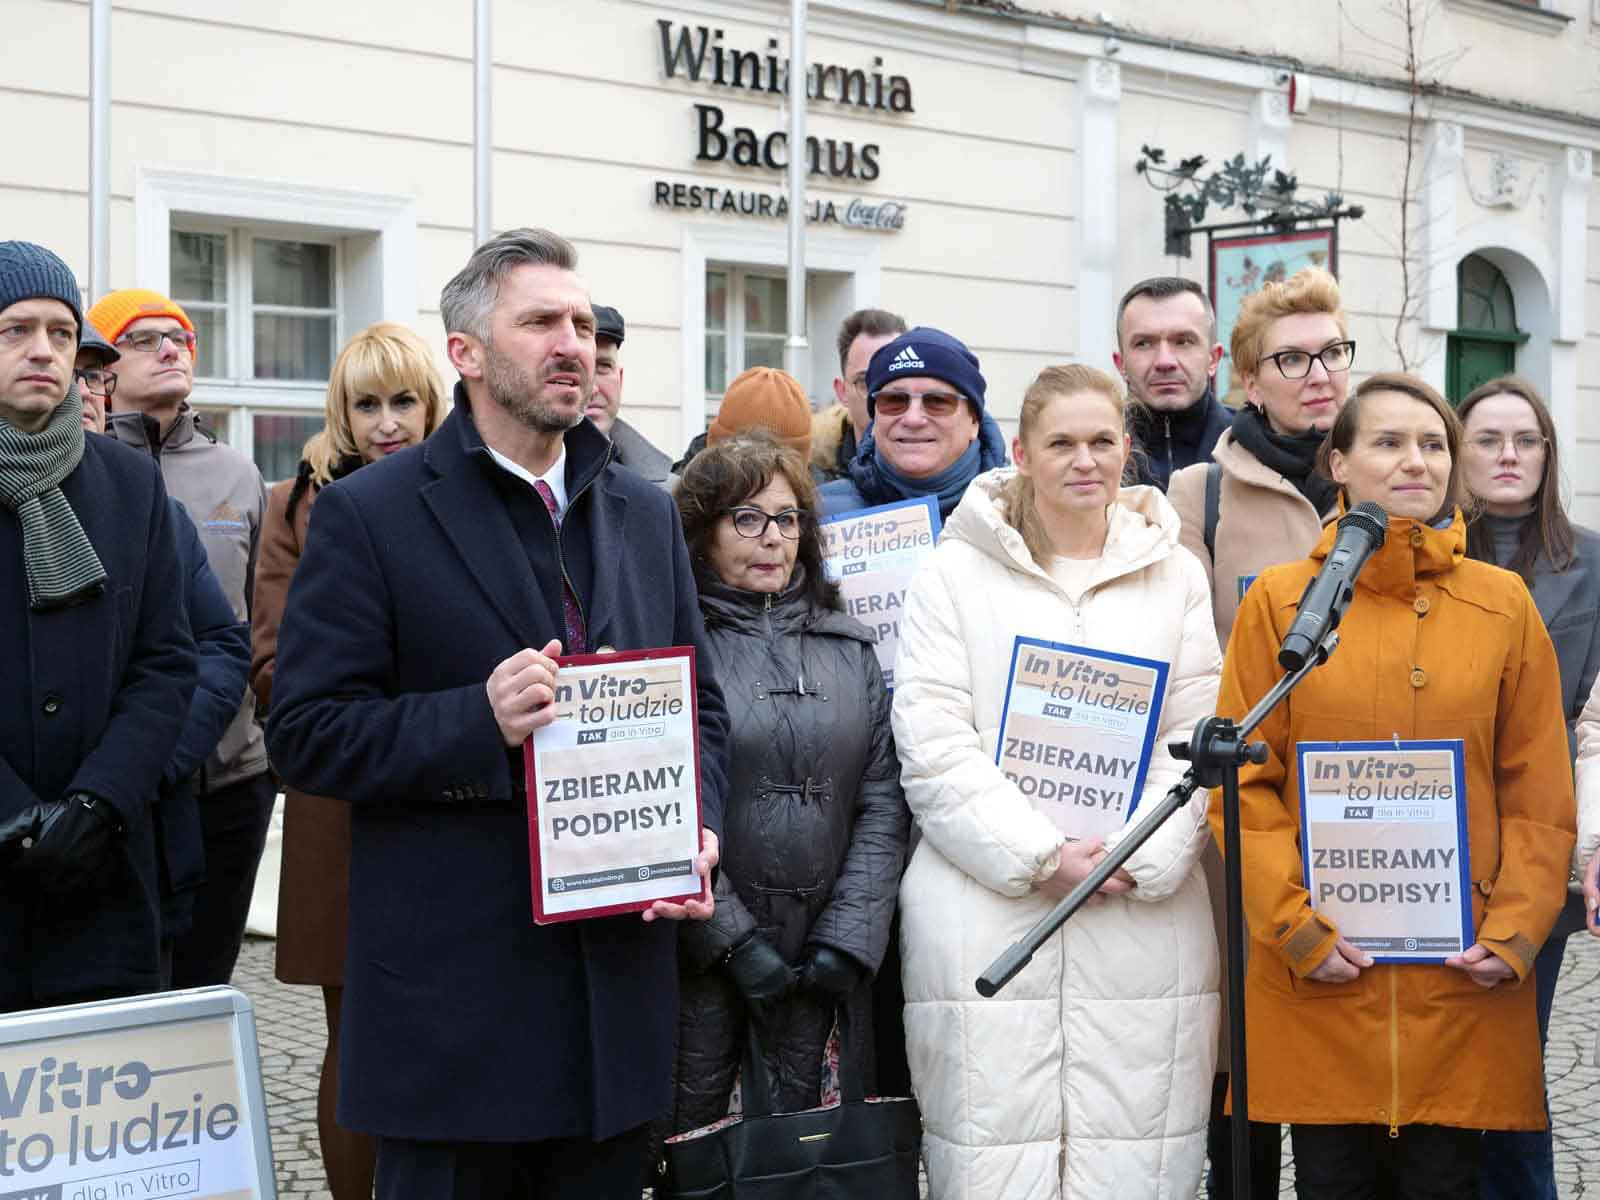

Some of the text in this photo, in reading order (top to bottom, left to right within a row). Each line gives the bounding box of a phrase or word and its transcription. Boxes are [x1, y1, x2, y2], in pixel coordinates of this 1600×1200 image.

[654, 181, 839, 223] RESTAURAJA
[888, 360, 925, 372] adidas
[841, 520, 898, 544] Vitro
[843, 529, 931, 561] to ludzie
[847, 590, 906, 617] IERA
[1024, 653, 1121, 688] In Vitro
[579, 674, 647, 700] Vitro
[1050, 681, 1150, 716] to ludzie
[579, 693, 683, 724] to ludzie
[1047, 705, 1067, 716] TAK
[582, 731, 603, 743] TAK
[1004, 737, 1137, 780] ZBIERAMY
[1313, 757, 1416, 780] In Vitro
[545, 764, 685, 803] ZBIERAMY
[1347, 779, 1453, 801] to ludzie
[552, 802, 682, 840] PODPISY!
[1313, 848, 1456, 869] ZBIERAMY
[1319, 882, 1451, 904] PODPISY!
[0, 1093, 239, 1177] to ludzie
[115, 1181, 134, 1197] In
[141, 1171, 191, 1193] Vitro
